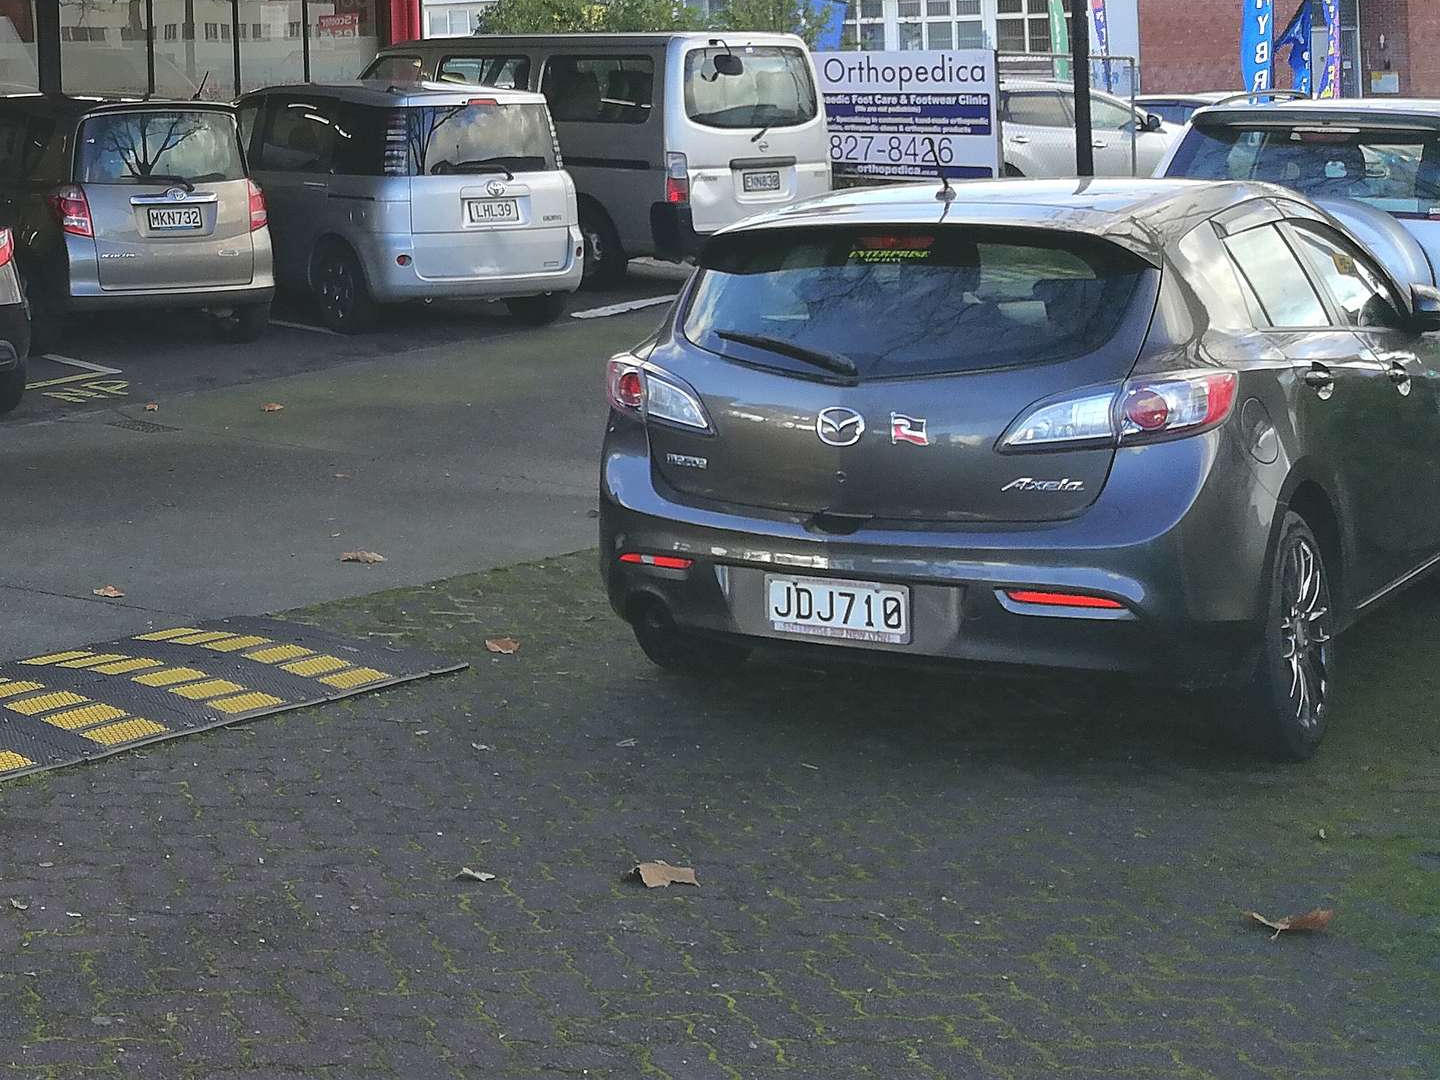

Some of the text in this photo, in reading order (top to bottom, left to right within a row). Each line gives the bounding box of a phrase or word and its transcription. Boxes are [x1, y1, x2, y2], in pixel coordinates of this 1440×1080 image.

[823, 54, 986, 91] Orthopedica
[851, 94, 873, 105] Foot
[874, 94, 898, 105] Care
[899, 94, 908, 105] &
[910, 94, 957, 105] Footwear
[958, 94, 988, 105] Clinic
[830, 134, 954, 164] 827-8426
[151, 210, 200, 227] MKN732
[475, 203, 512, 218] LHL39
[1000, 477, 1085, 492] Axela
[774, 586, 902, 629] JDJ710
